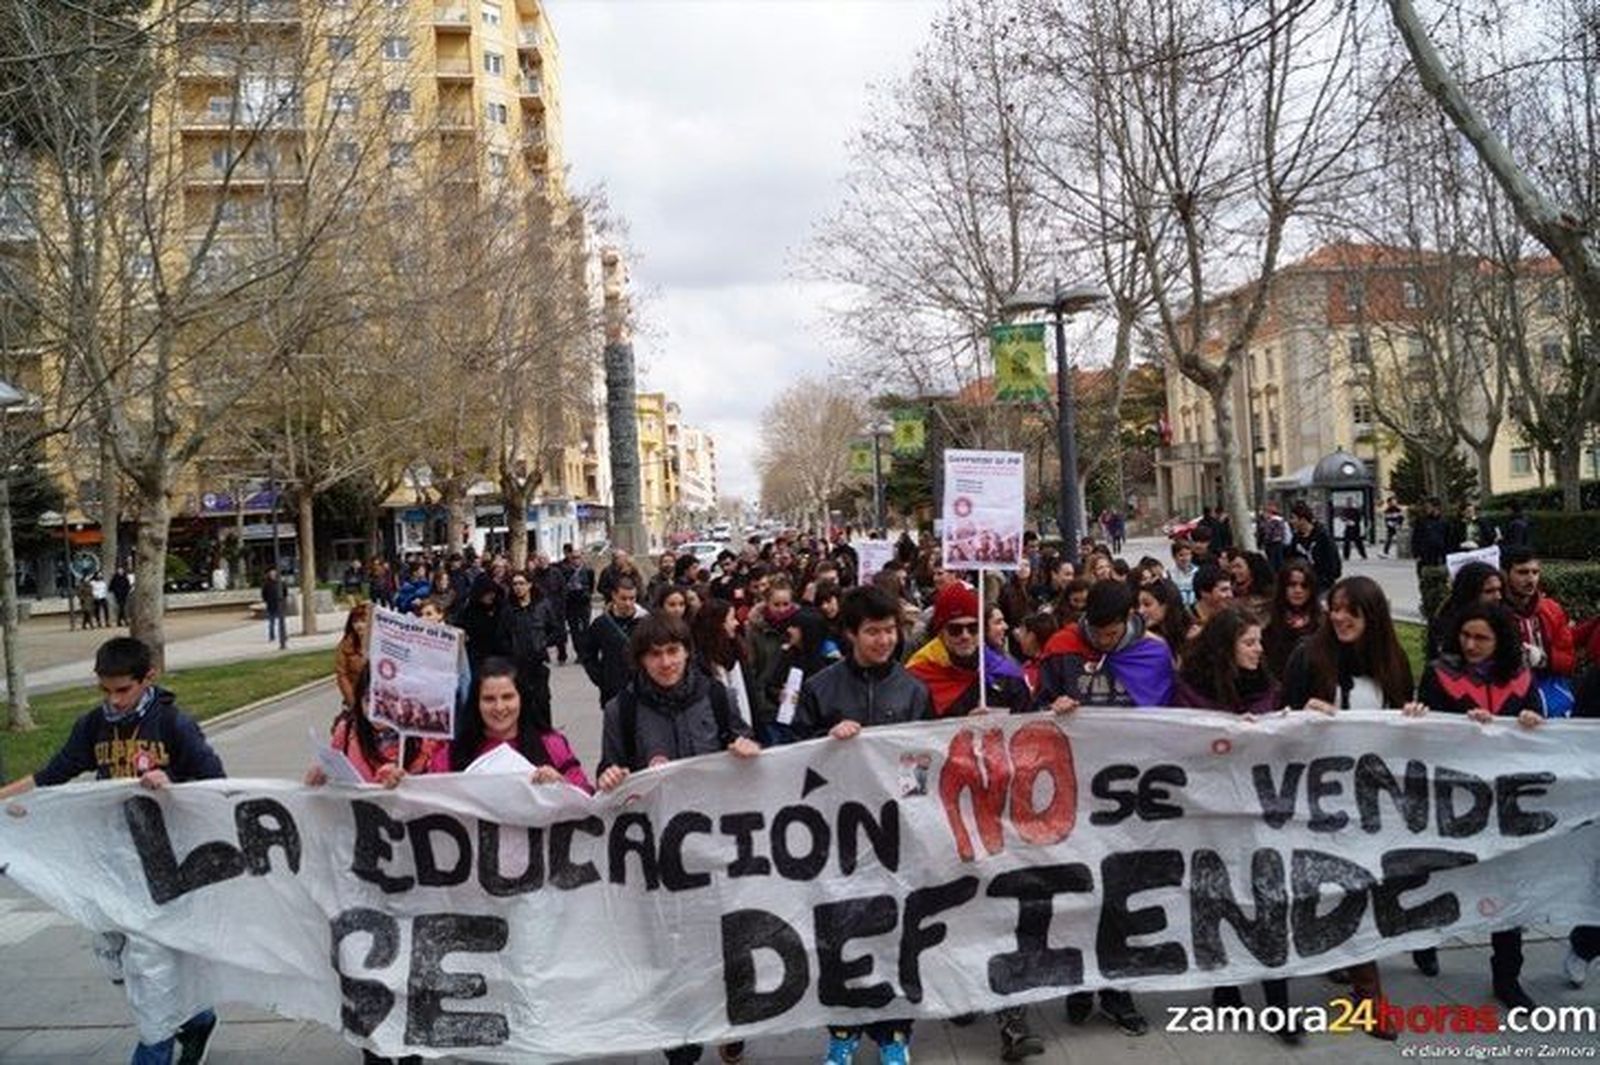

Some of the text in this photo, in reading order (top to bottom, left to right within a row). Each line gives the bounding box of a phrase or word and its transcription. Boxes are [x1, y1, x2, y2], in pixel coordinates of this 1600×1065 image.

[124, 720, 1558, 904] LA EDUCACIÓN NO SE VENDE
[330, 847, 1478, 1048] SE DEFIENDE
